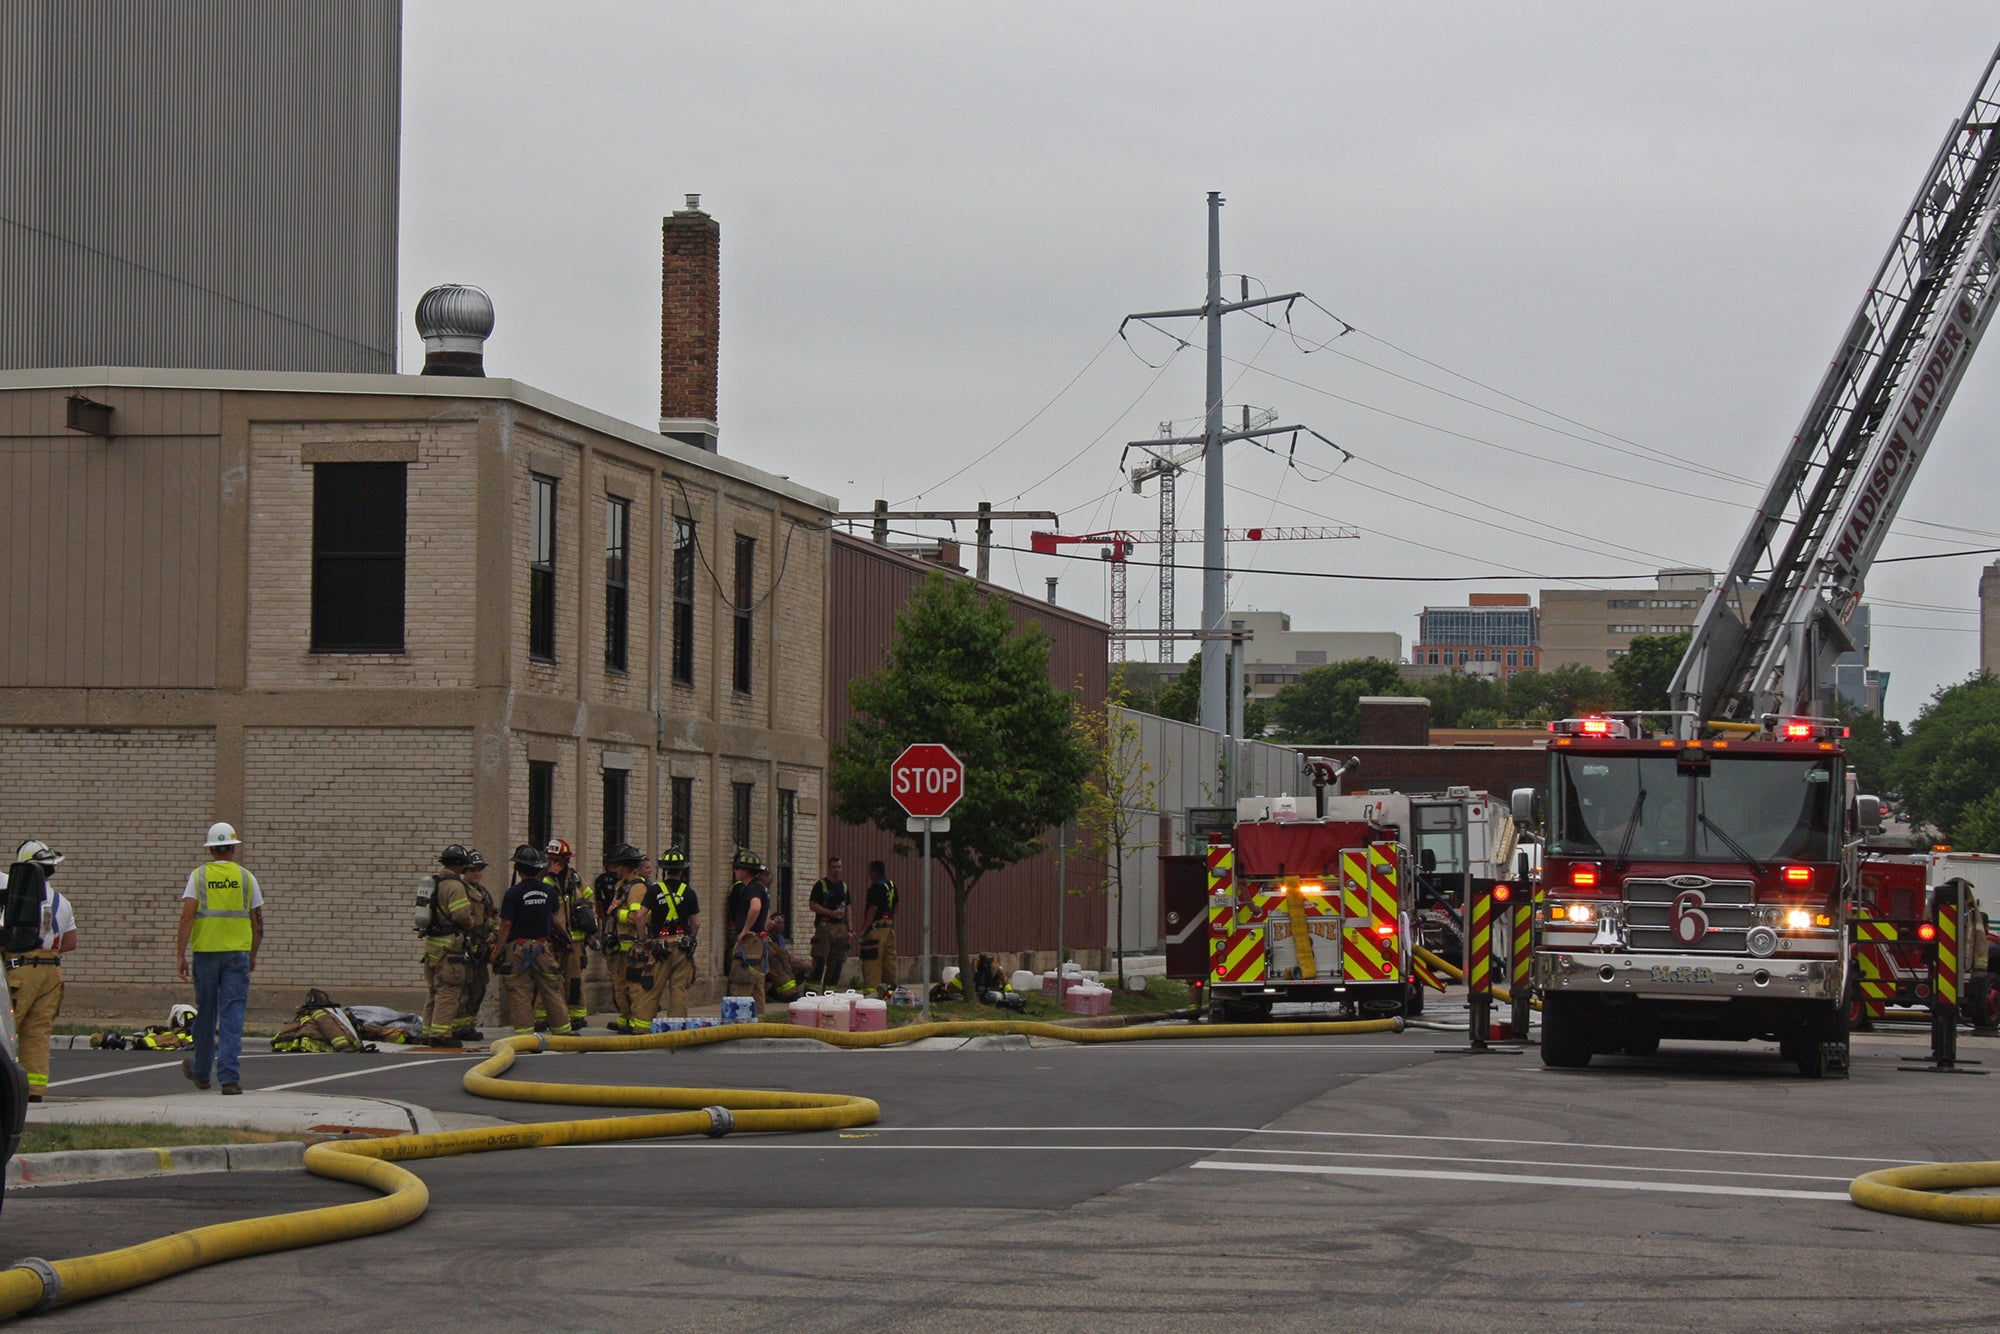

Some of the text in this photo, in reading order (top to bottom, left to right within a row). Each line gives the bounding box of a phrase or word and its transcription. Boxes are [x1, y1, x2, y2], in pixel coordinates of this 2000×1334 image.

[1836, 300, 1973, 563] MADISON LADDER 6
[896, 767, 958, 794] STOP
[1668, 889, 1709, 945] 6
